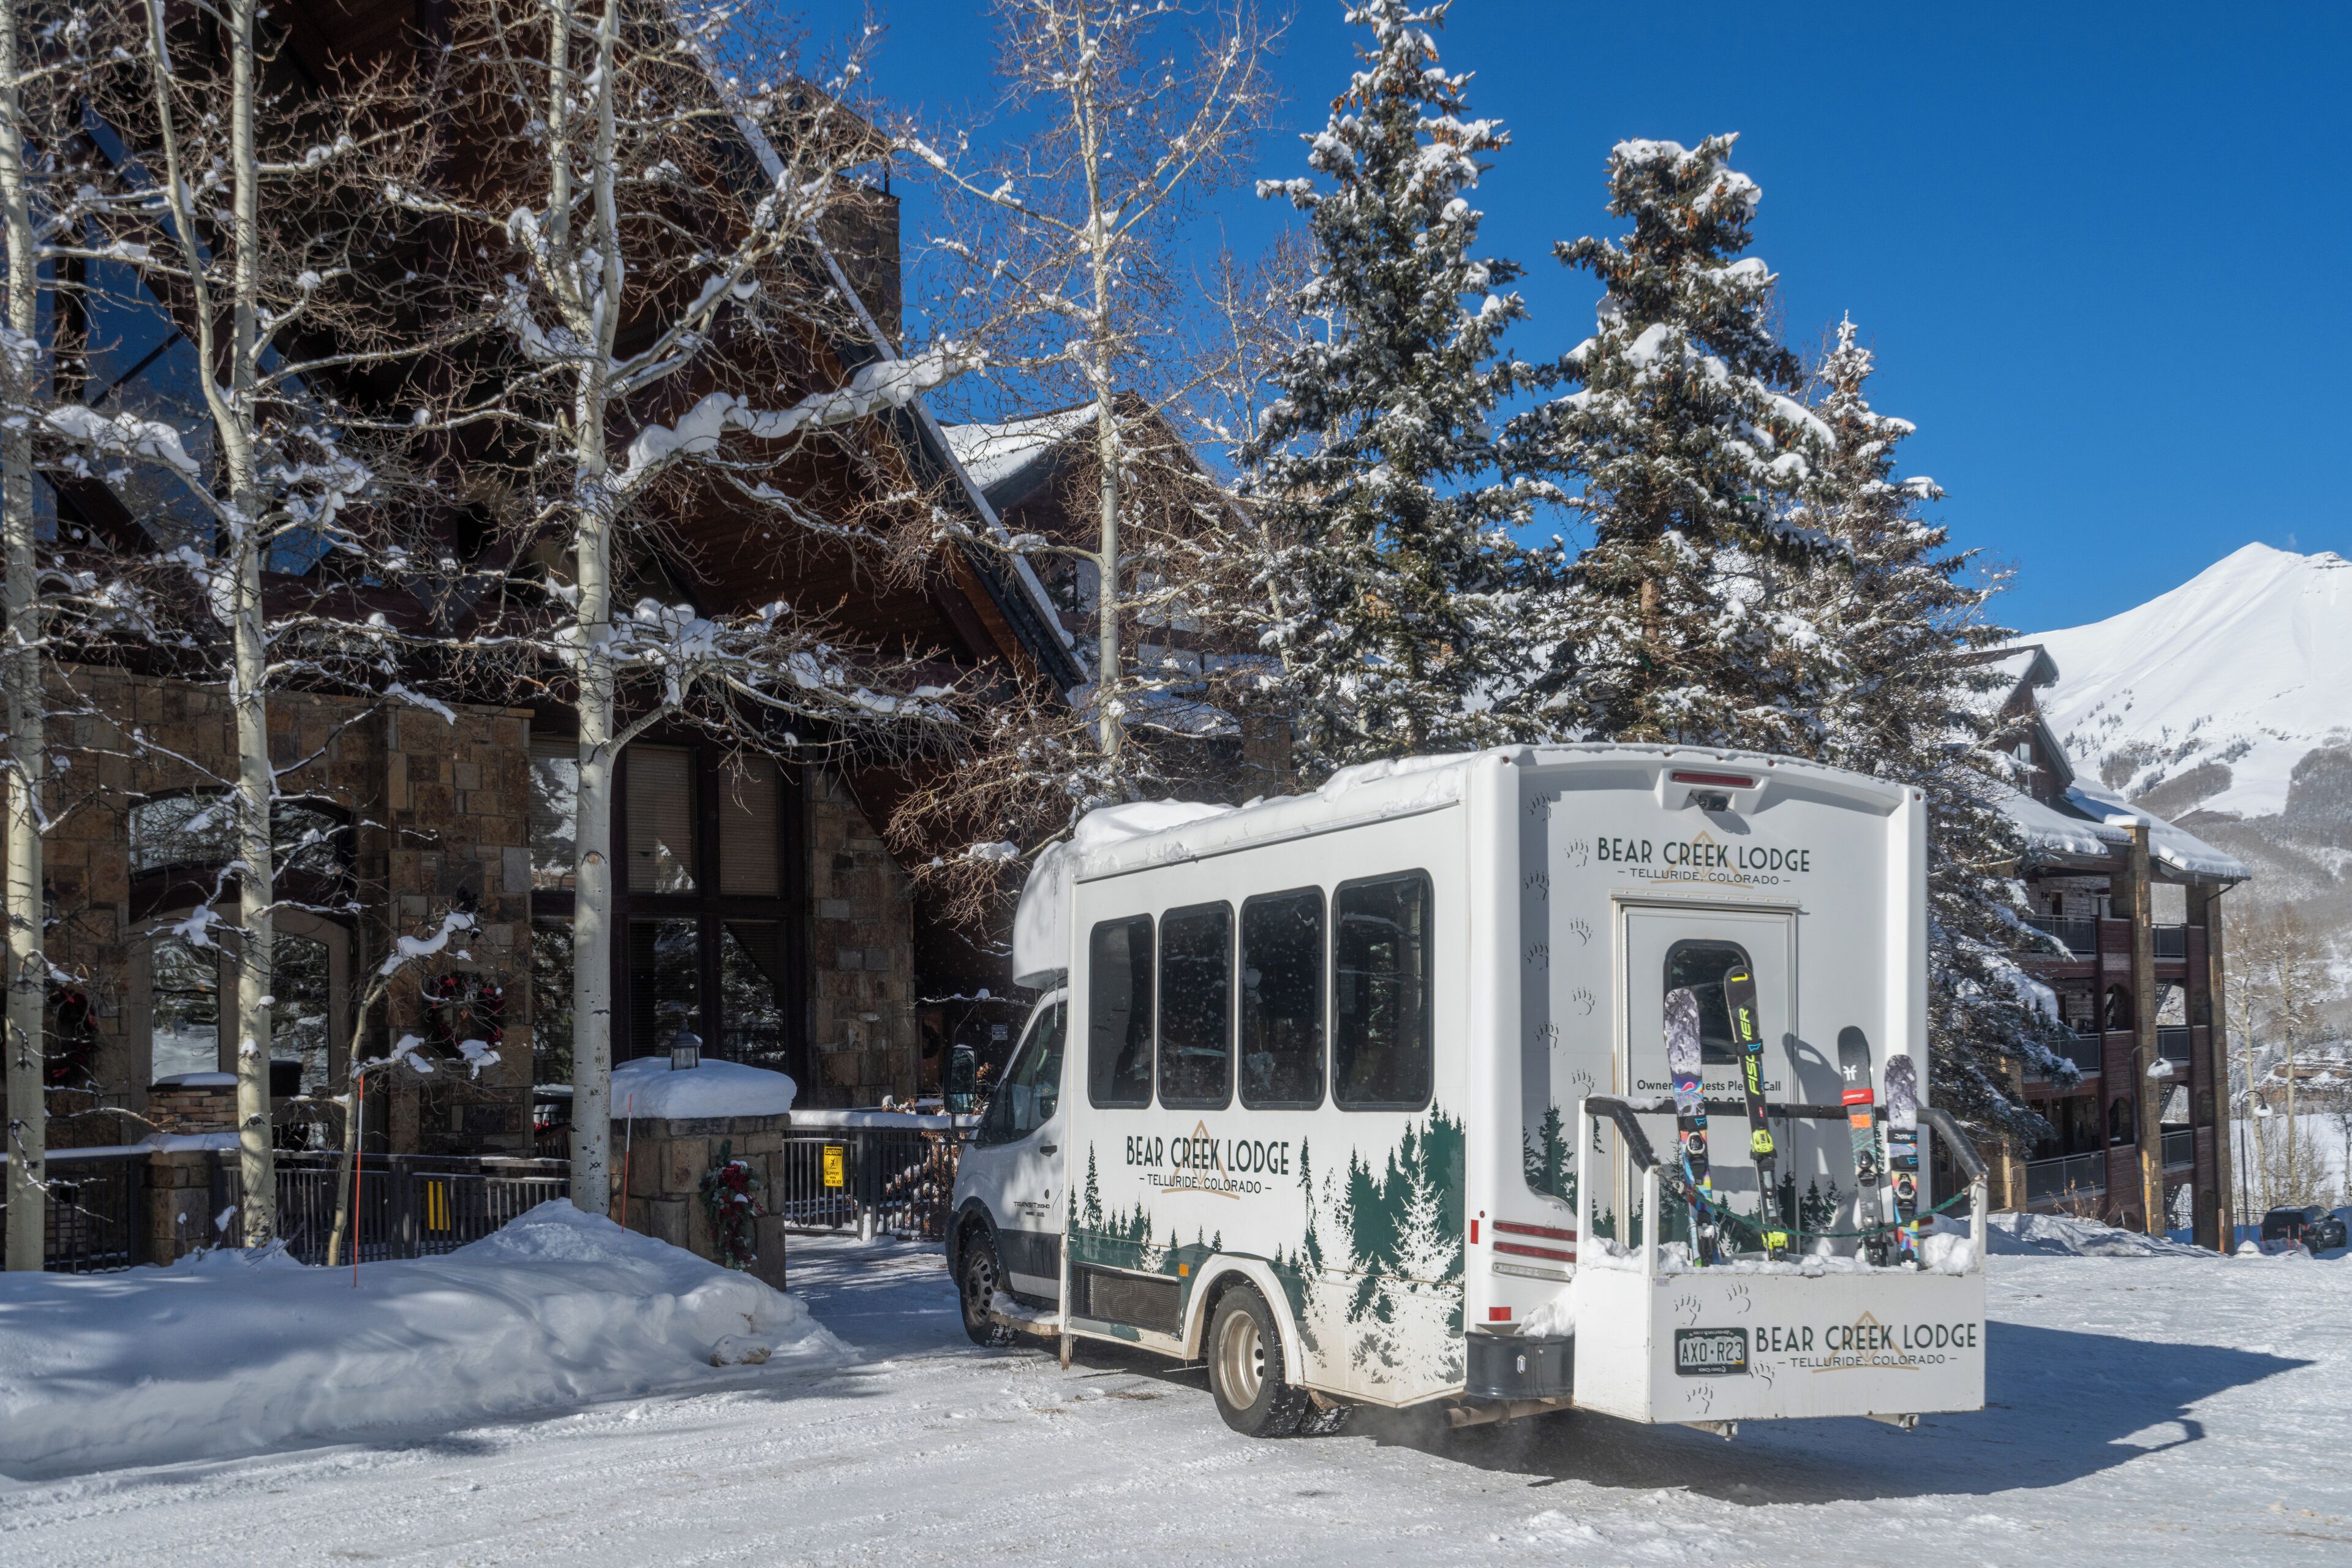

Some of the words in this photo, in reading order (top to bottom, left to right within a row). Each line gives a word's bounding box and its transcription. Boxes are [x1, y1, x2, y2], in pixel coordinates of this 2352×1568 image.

[1598, 837, 1652, 864] BEAR
[1664, 842, 1728, 868] CREEK
[1739, 846, 1810, 872] LODGE
[1630, 868, 1704, 881] TELLURIDE,
[1708, 872, 1779, 885] COLORADO
[1763, 1080, 1781, 1091] Call
[1126, 1136, 1163, 1167] BEAR
[1170, 1137, 1220, 1170] CREEK
[1228, 1139, 1289, 1175] LODGE
[1147, 1174, 1200, 1190] TELLURIDE,
[1204, 1177, 1262, 1194] COLORADO
[1756, 1326, 1814, 1352] BEAR
[1825, 1325, 1892, 1351] CREEK
[1904, 1323, 1976, 1349] LODGE
[1790, 1356, 1867, 1367] TELLURIDE,
[1872, 1354, 1945, 1366] COLORADO
